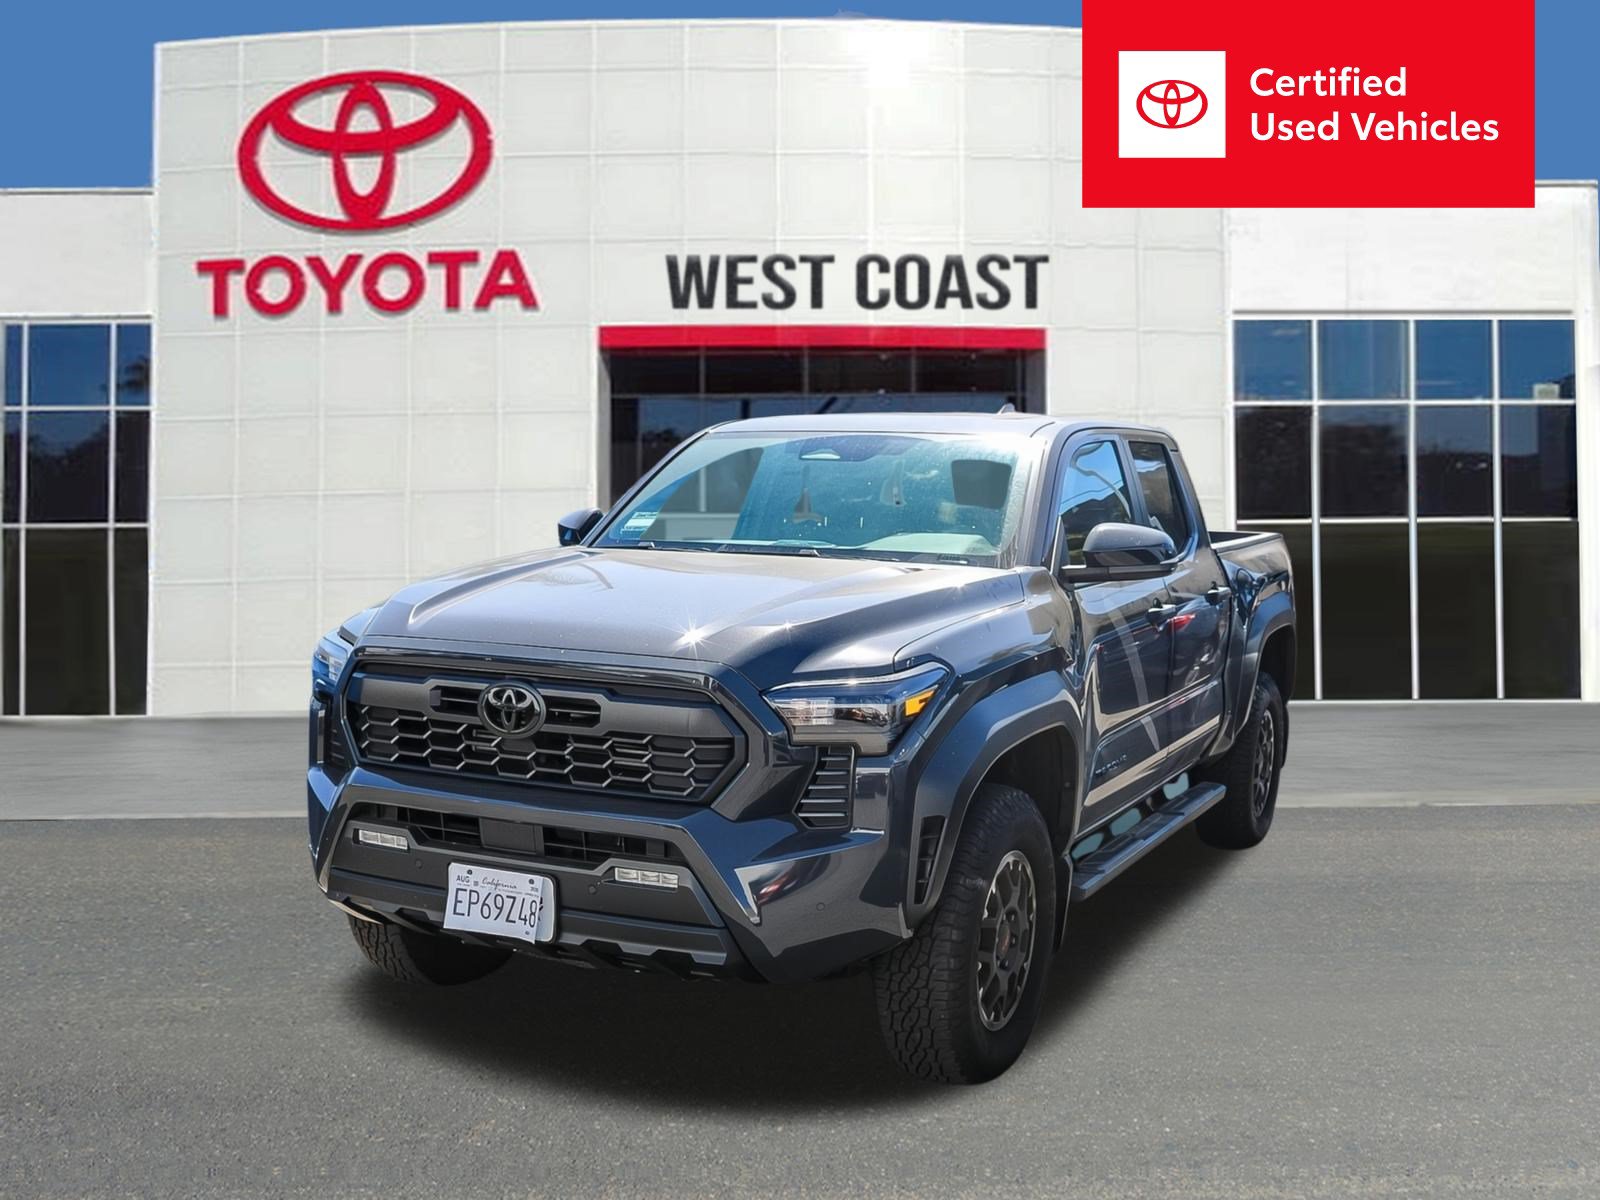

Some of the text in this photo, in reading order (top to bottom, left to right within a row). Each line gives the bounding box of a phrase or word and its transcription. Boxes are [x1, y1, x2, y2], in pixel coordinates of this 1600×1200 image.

[196, 249, 539, 317] TOYOTA
[665, 254, 1050, 310] WEST COAST
[456, 874, 470, 883] AUG
[481, 876, 518, 891] California
[452, 887, 538, 928] EP69Z48
